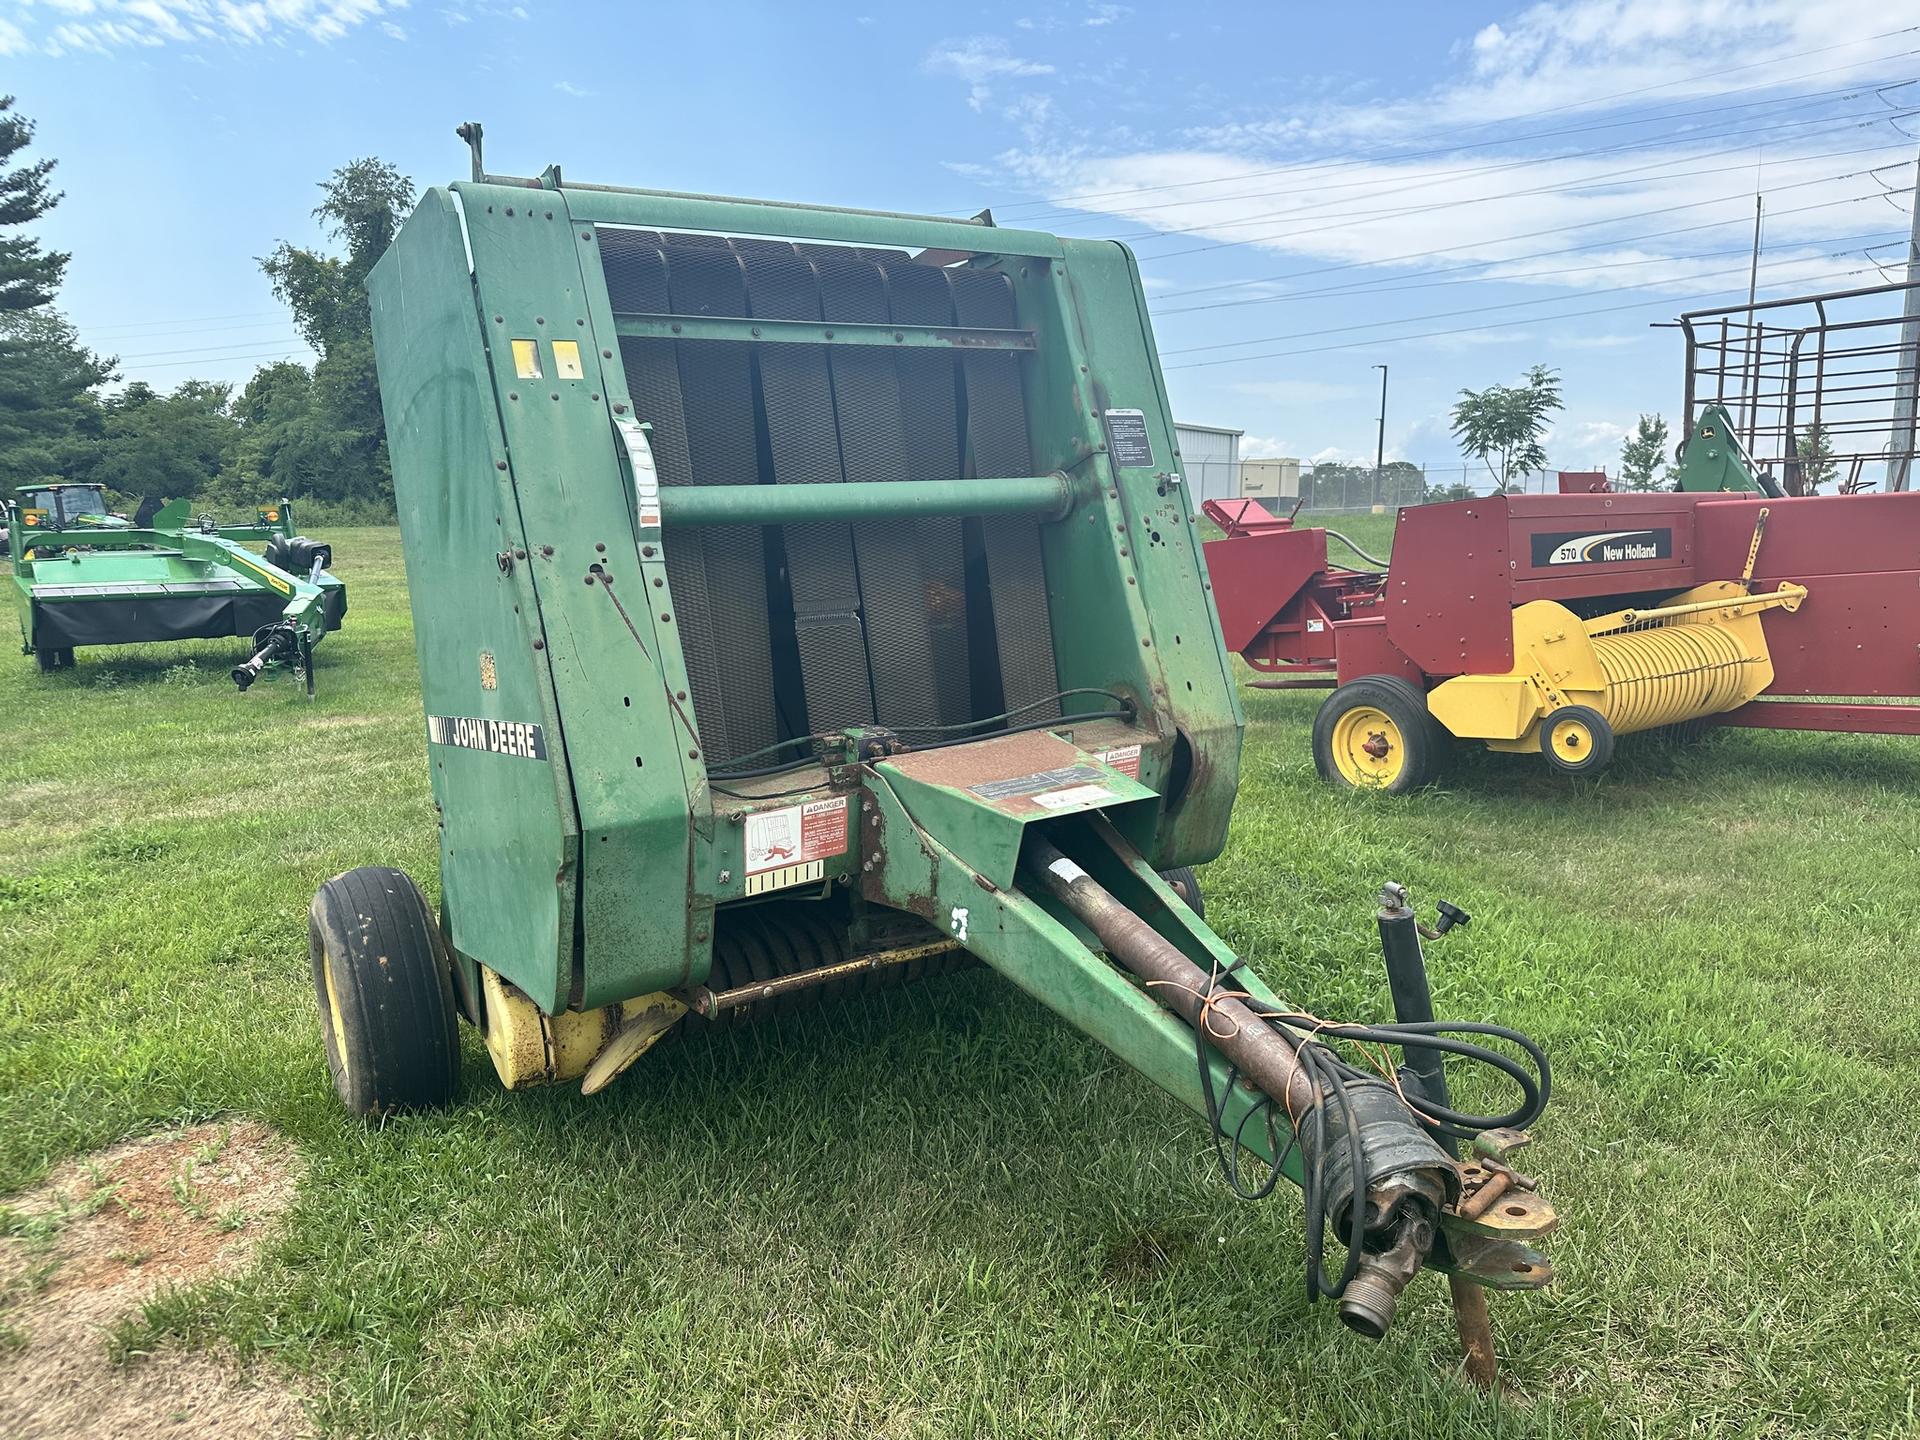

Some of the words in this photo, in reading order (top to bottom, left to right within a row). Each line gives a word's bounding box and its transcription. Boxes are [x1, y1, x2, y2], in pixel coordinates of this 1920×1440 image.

[1560, 548, 1577, 561] 570
[1603, 545, 1624, 562] New
[1625, 542, 1657, 561] Holland
[453, 718, 487, 751] JOHN
[489, 720, 536, 759] DEERE
[1114, 749, 1138, 759] DANGER
[813, 799, 845, 812] DANGER
